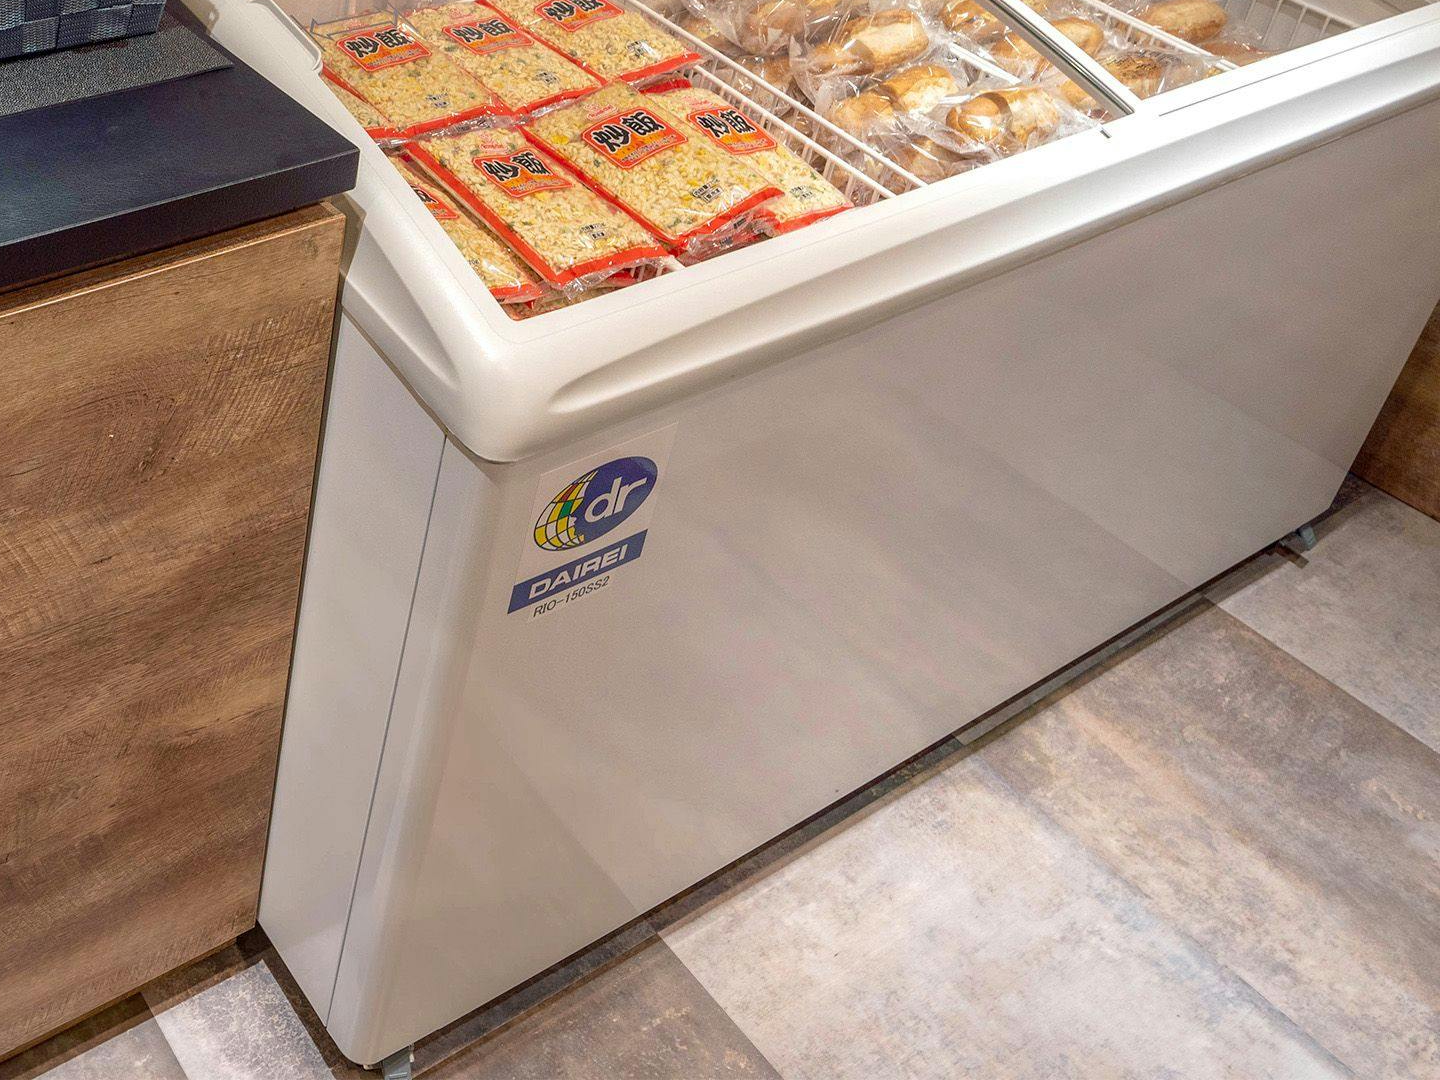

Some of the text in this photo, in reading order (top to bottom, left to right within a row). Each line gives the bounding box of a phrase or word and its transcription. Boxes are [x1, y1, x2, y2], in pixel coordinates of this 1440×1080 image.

[346, 28, 415, 58] 炒飯
[451, 20, 516, 43] 炒飯
[591, 111, 665, 153] 炒飯
[697, 110, 756, 138] 炒飯
[482, 152, 553, 182] 炒飯
[584, 477, 647, 523] dr
[529, 544, 628, 599] DAIREI
[533, 576, 610, 617] RIO-150SS2
